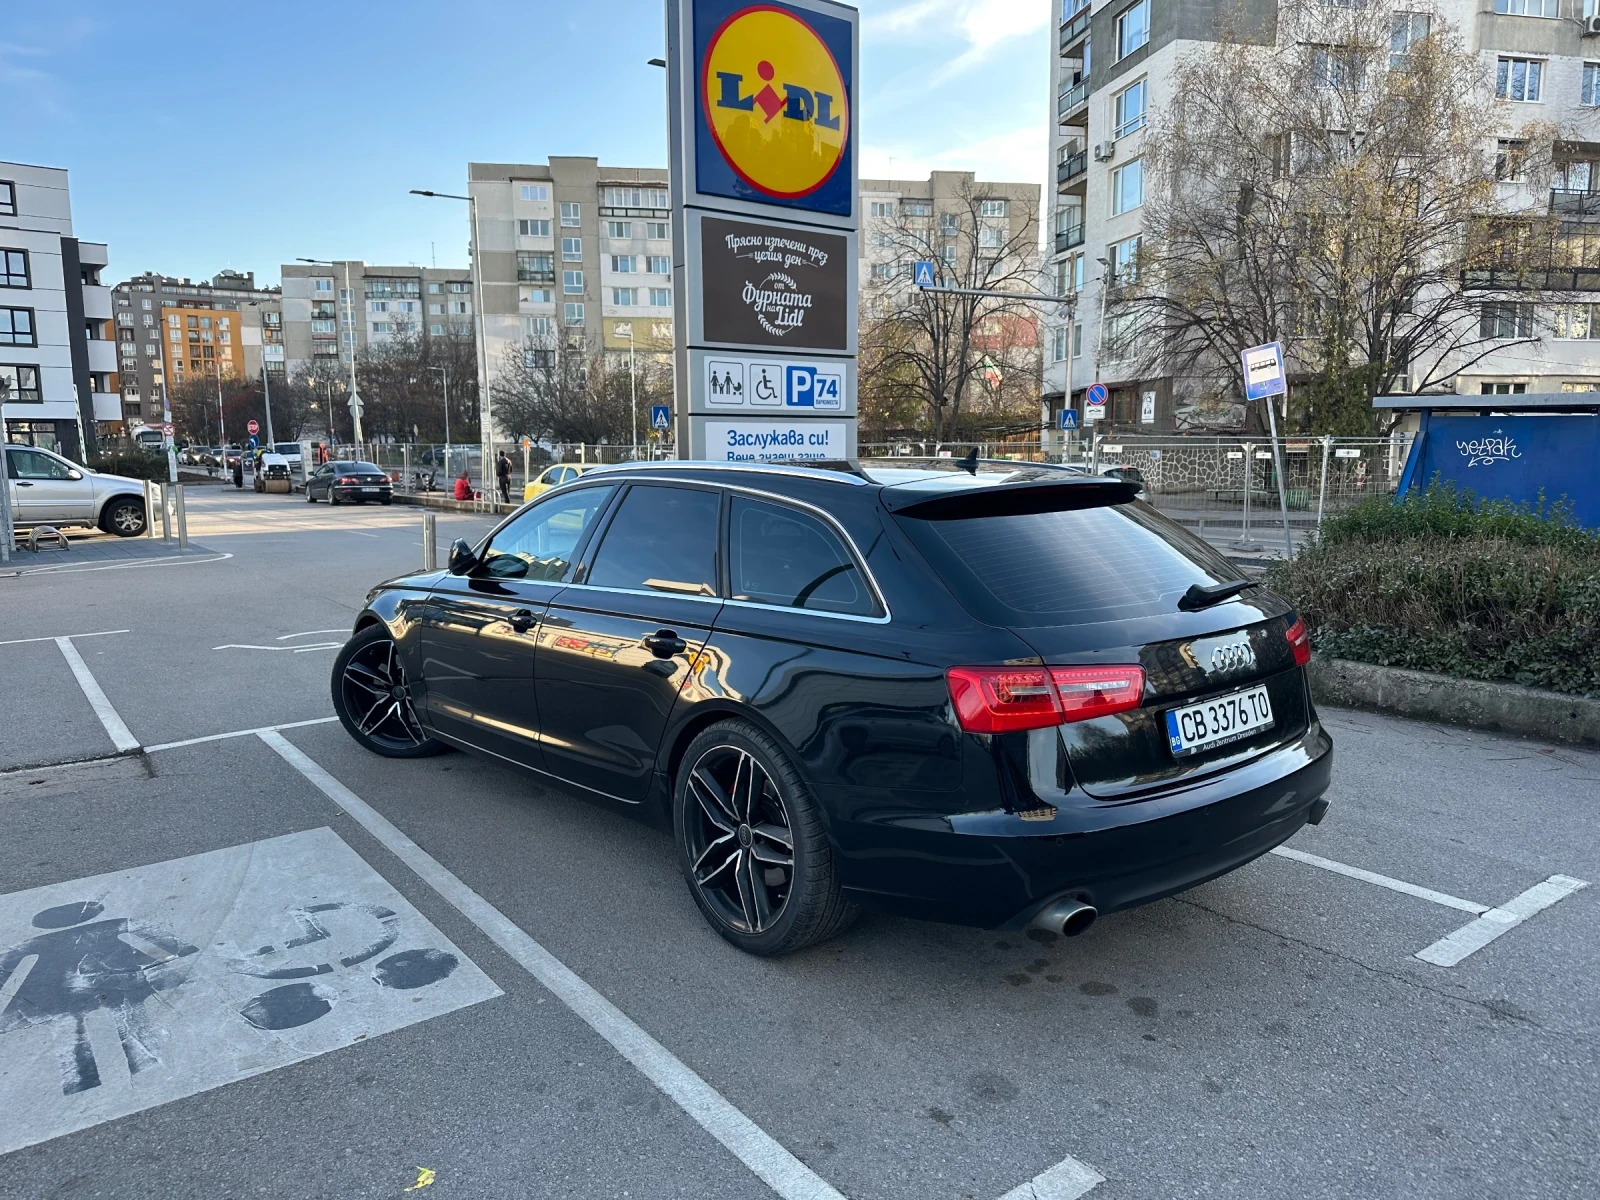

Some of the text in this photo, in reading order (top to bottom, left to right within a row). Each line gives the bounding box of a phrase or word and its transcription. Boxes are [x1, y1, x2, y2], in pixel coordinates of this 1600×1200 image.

[725, 234, 828, 266] Прясно изпечени през
[754, 251, 801, 268] целия ден
[742, 280, 812, 312] Фурната
[774, 282, 785, 290] от
[774, 305, 804, 326] Lidl
[792, 369, 812, 403] P
[816, 379, 838, 398] 74
[727, 430, 829, 449] Заслужава си!
[1181, 710, 1208, 742] CB
[1208, 697, 1249, 734] 3376
[1171, 737, 1181, 746] BG
[1202, 729, 1257, 750] Audi Zentrum Dresden
